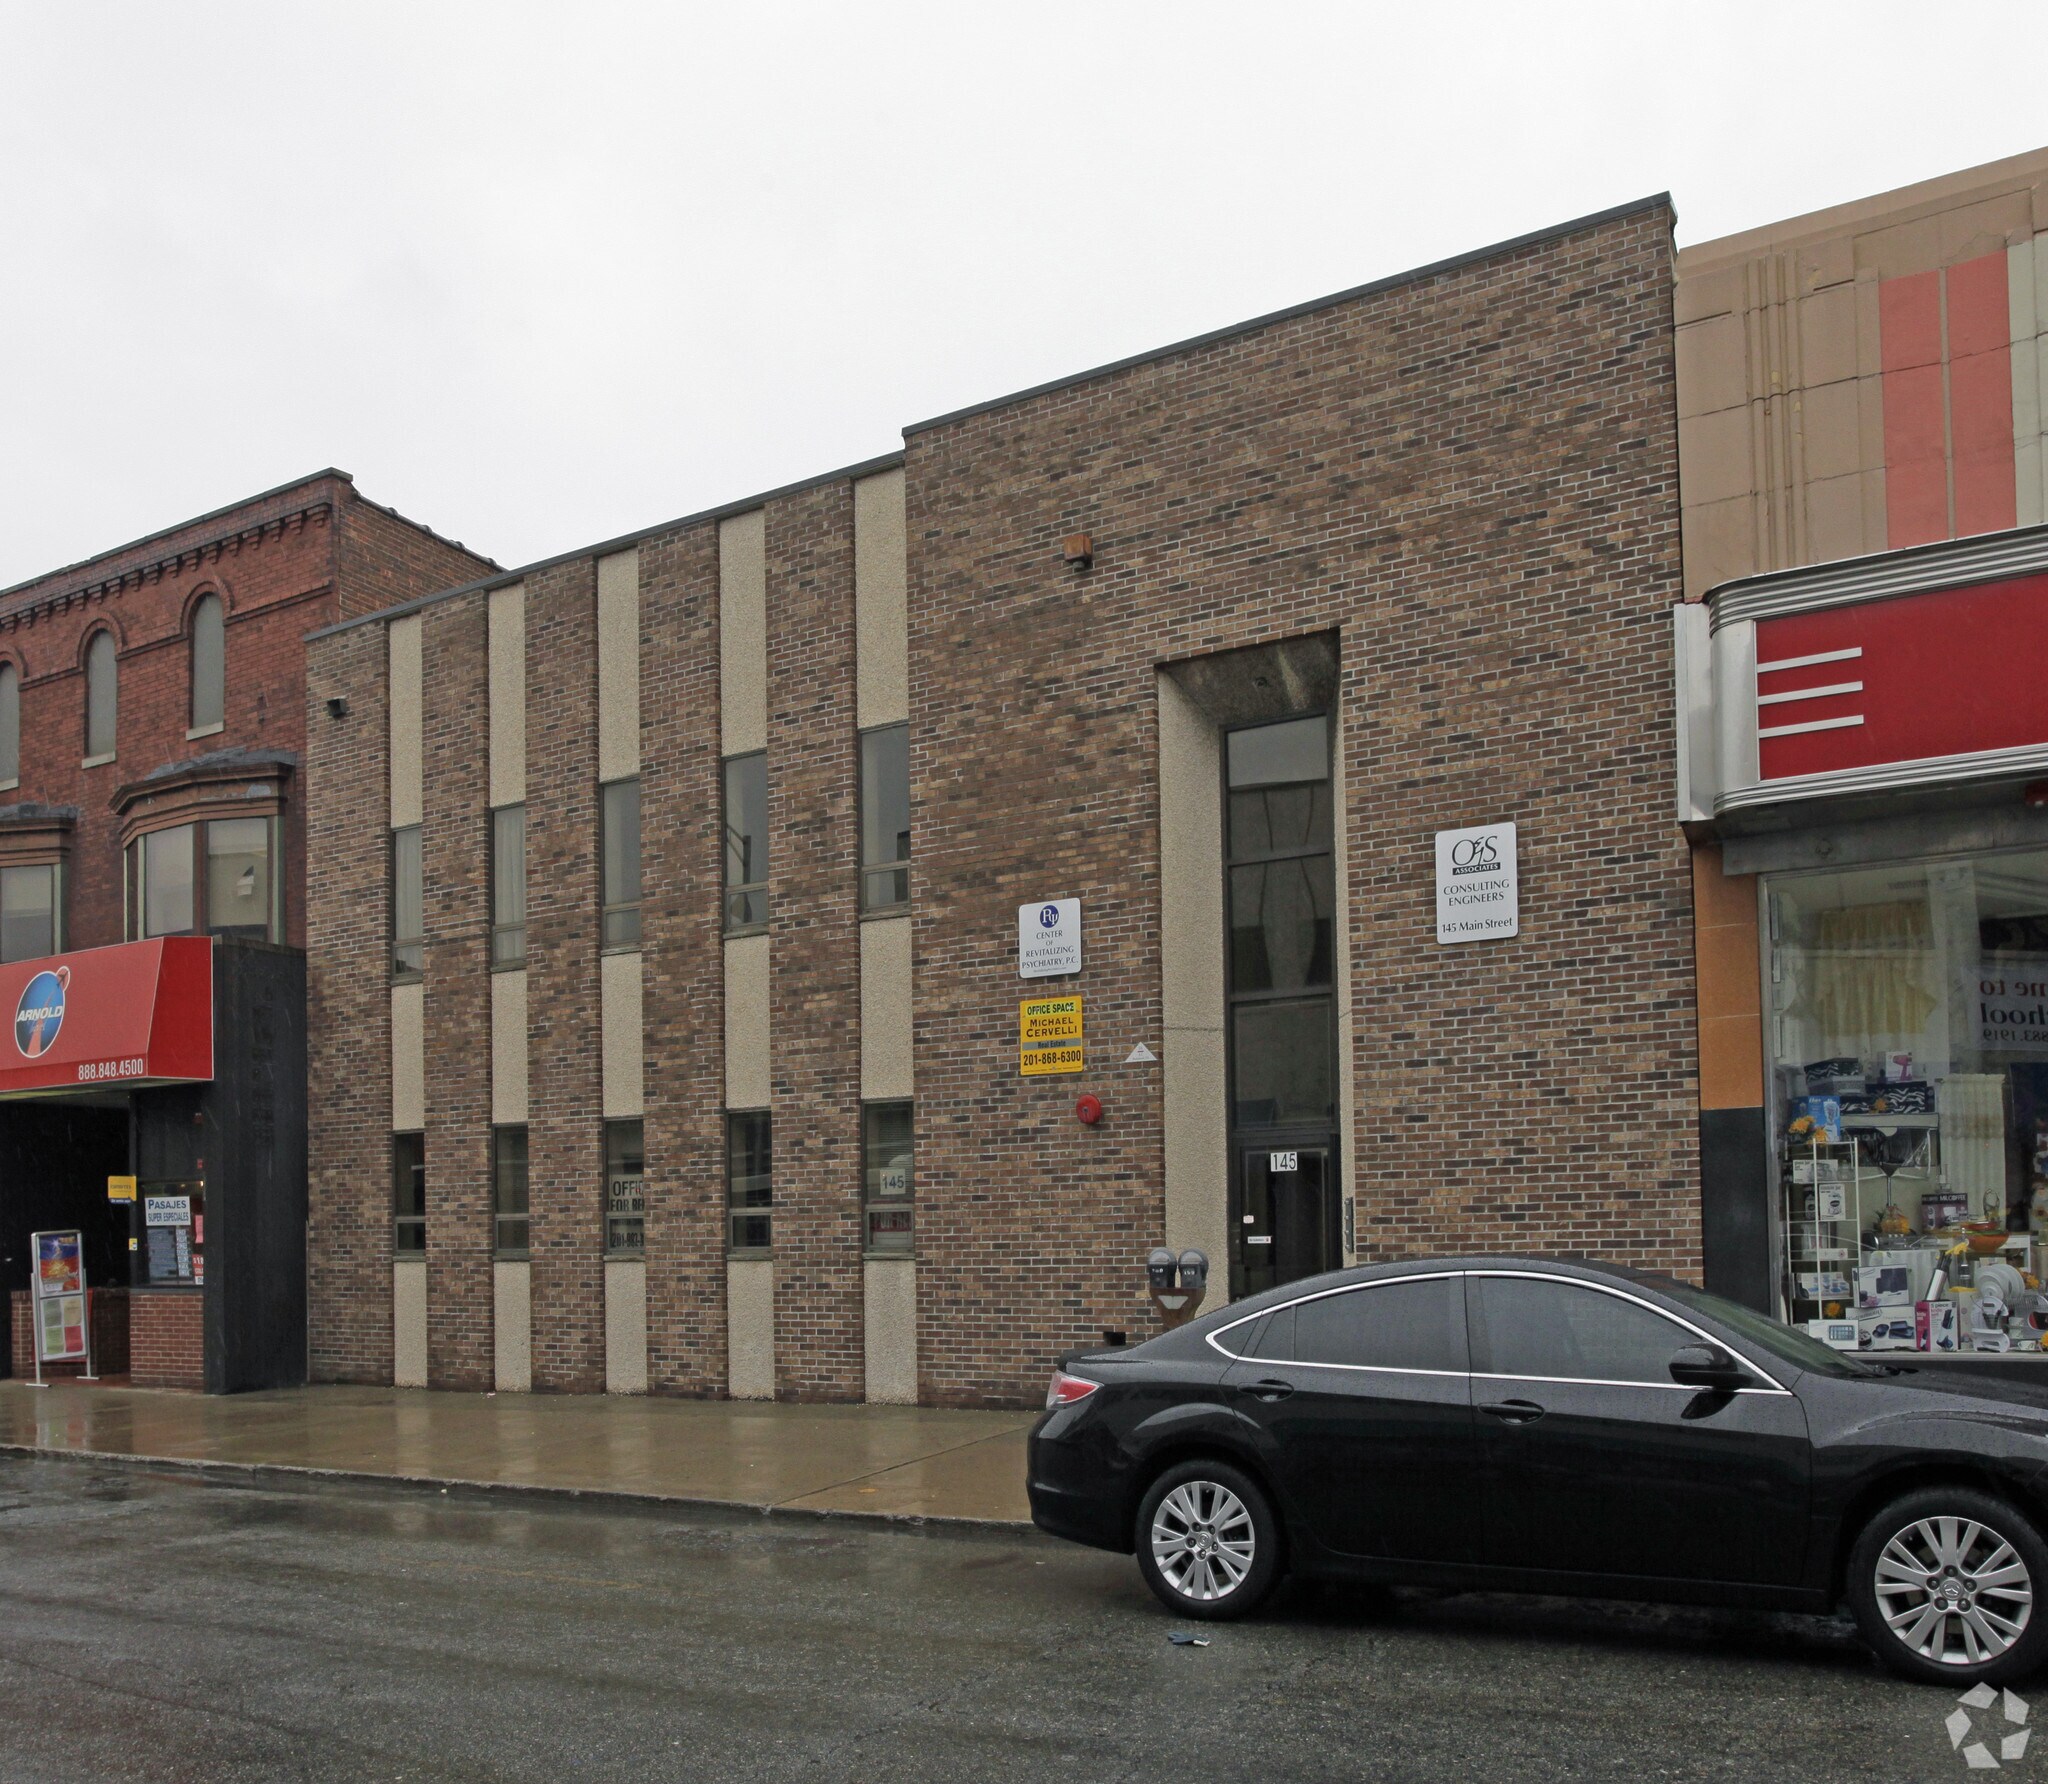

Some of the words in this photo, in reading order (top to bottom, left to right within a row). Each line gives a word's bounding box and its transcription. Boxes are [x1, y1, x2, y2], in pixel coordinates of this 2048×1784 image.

[1455, 864, 1498, 874] ASSOCIATES
[1443, 879, 1510, 895] CONSULTING
[1448, 891, 1504, 906] ENGINEERS
[1442, 923, 1456, 933] 145
[1459, 920, 1482, 931] Main
[1485, 917, 1512, 929] Street
[1036, 930, 1063, 940] CENTER
[1026, 945, 1074, 957] REVITALIZING
[17, 1005, 63, 1022] ARNOLD
[1027, 1004, 1051, 1015] OFFICE
[1052, 1002, 1074, 1013] SPACE
[1030, 1017, 1074, 1027] MICHAEL
[1026, 1026, 1077, 1037] CERVELLI
[1037, 1041, 1049, 1049] Real
[1050, 1040, 1066, 1048] Estate
[1023, 1050, 1081, 1066] 201-868-6300
[78, 1058, 143, 1080] 888.848.4500
[1273, 1153, 1296, 1170] 145
[882, 1175, 904, 1189] 145
[148, 1199, 186, 1209] PASAJES
[610, 1199, 629, 1211] FOR
[148, 1213, 162, 1222] SUPER
[163, 1212, 189, 1222] ESPECIALES
